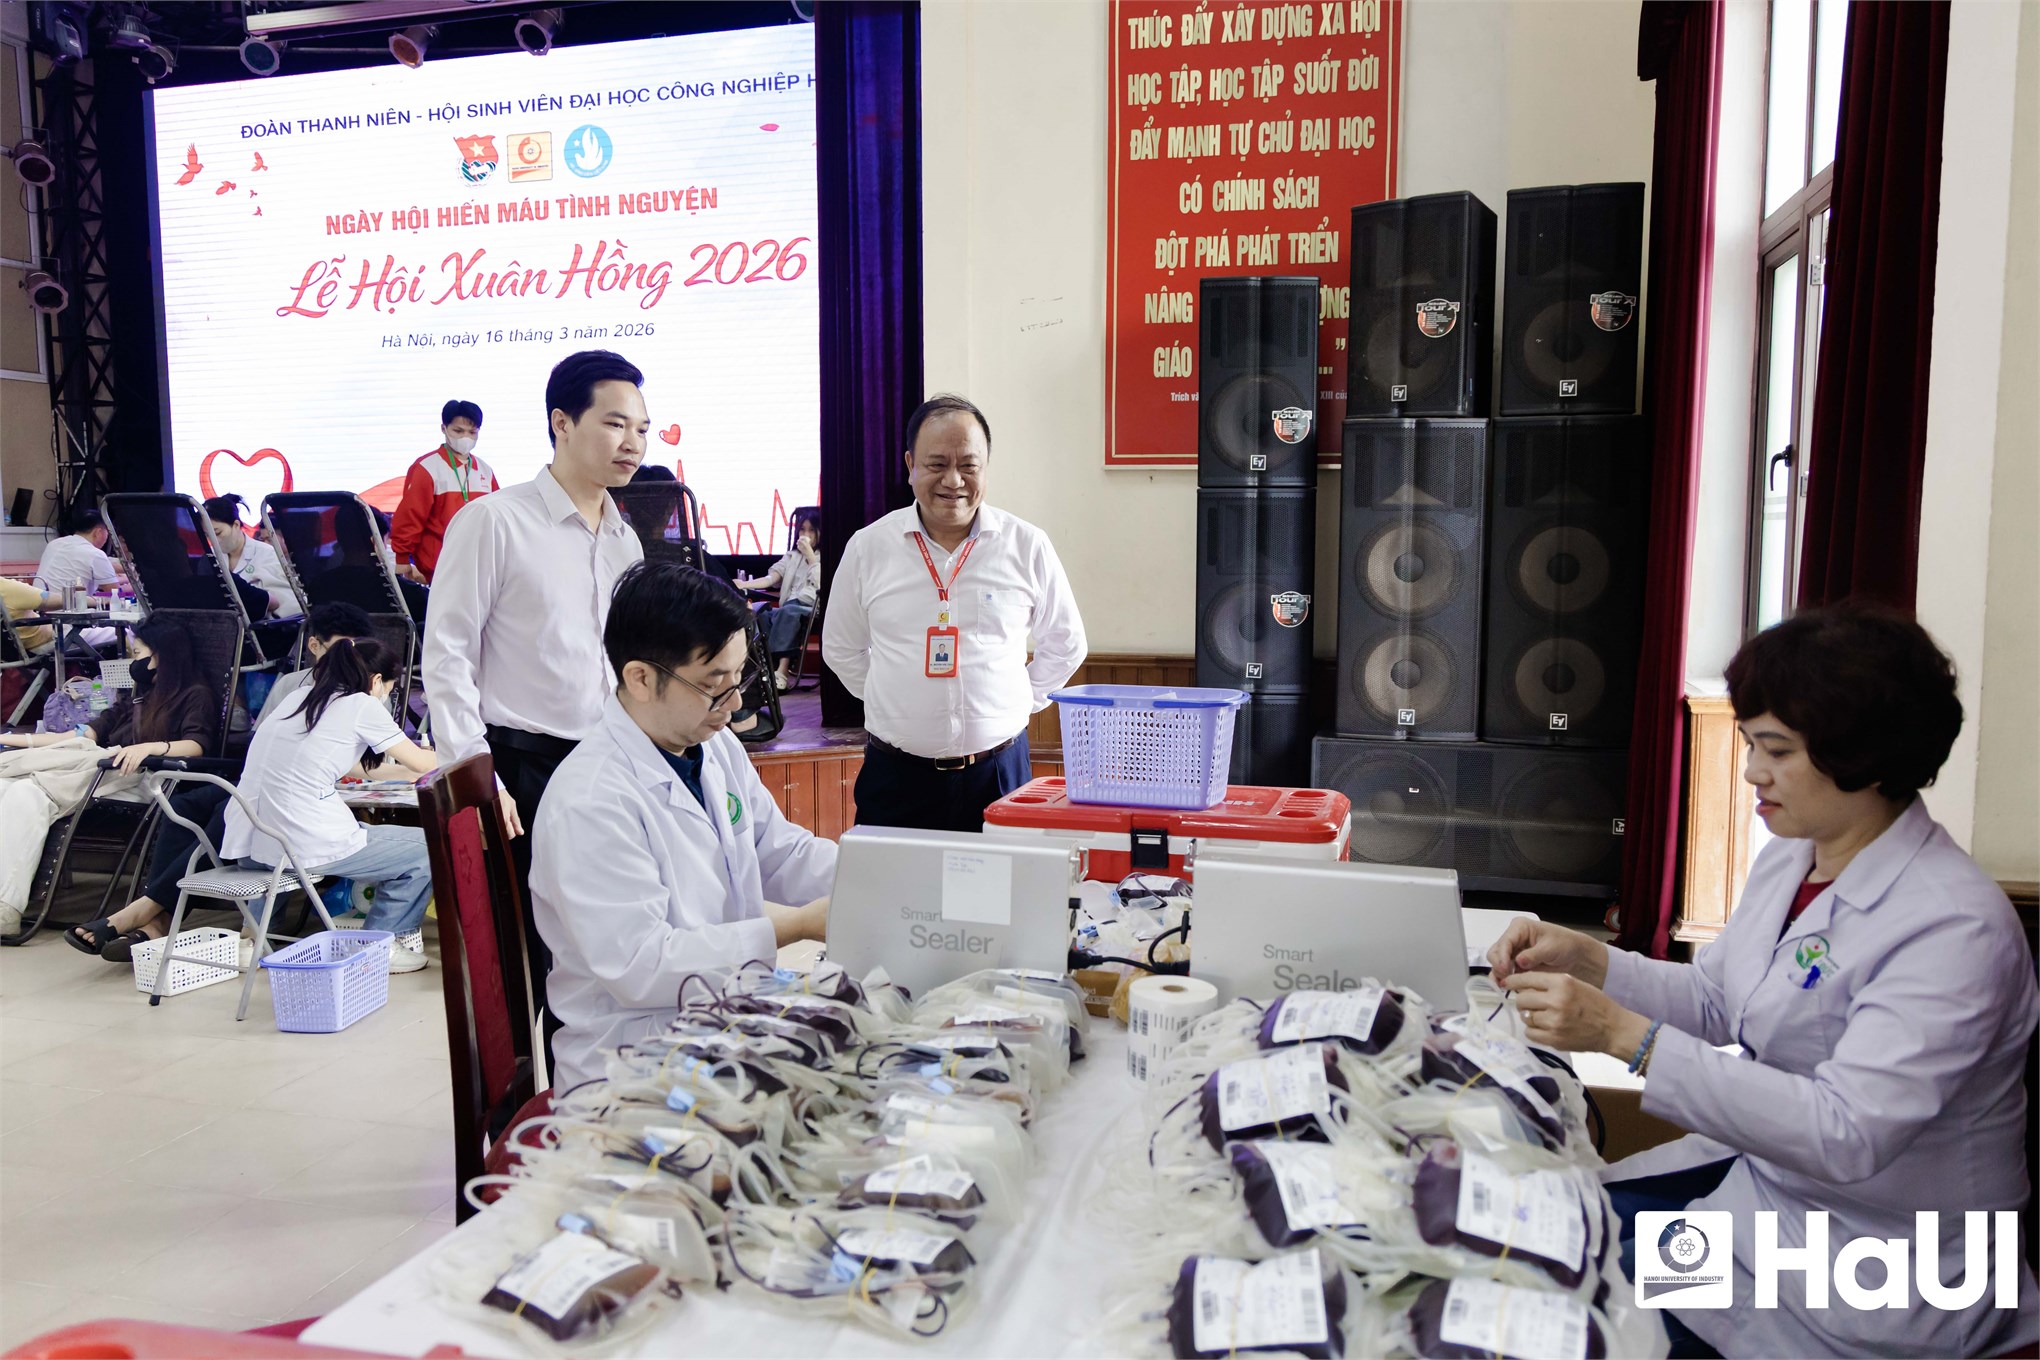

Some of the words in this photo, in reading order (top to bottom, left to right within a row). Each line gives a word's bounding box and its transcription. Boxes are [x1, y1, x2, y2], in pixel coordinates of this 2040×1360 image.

[1127, 9, 1172, 50] THÚC
[1181, 0, 1214, 47] ĐẨY
[1221, 2, 1256, 44] XÂY
[1261, 3, 1313, 46] DỰNG
[1127, 72, 1162, 112] HỌC
[1169, 63, 1202, 109] TẬP,
[1209, 66, 1245, 107] HỌC
[1251, 58, 1285, 104] TẬP
[1293, 47, 1342, 95] SUỐT
[1347, 48, 1380, 92] ĐỜI
[241, 119, 292, 139] ĐOÀN
[296, 114, 361, 134] THANH
[366, 107, 411, 127] NIÊN
[428, 102, 460, 124] HỘI
[467, 100, 512, 119] SINH
[517, 93, 563, 114] VIÊN
[568, 91, 601, 113] ĐẠI
[608, 87, 650, 110] HỌC
[656, 81, 715, 101] CÔNG
[722, 71, 800, 95] NGHIỆP
[807, 73, 817, 88] H
[1129, 115, 1162, 161] ĐẨY
[1167, 124, 1221, 164] MẠNH
[1228, 119, 1254, 162] TỰ
[1257, 109, 1294, 155] CHỦ
[1299, 117, 1331, 158] ĐẠI
[1338, 115, 1375, 156] HỌC
[326, 209, 383, 236] NGÀY
[391, 206, 429, 234] HỘI
[437, 199, 490, 228] HIẾN
[497, 196, 549, 223] MÁU
[555, 193, 610, 220] TÌNH
[618, 186, 718, 216] NGUYỆN
[1179, 174, 1203, 214] CÓ
[1212, 171, 1266, 213] CHÍNH
[1272, 168, 1320, 210] SÁCH
[1154, 229, 1189, 276] ĐỘT
[1194, 228, 1231, 268] PHÁ
[1236, 225, 1281, 266] PHÁT
[1287, 215, 1339, 265] TRIỂN
[275, 254, 346, 319] Lễ
[346, 254, 426, 315] Hội
[430, 248, 551, 306] Xuân
[554, 239, 673, 310] Hồng
[683, 236, 811, 288] 2026
[1144, 285, 1194, 324] NÂNG
[1319, 284, 1350, 326] ỢNG
[381, 333, 402, 348] Hà
[407, 333, 436, 350] Nội,
[441, 331, 480, 348] ngày
[486, 330, 504, 343] 16
[508, 328, 553, 344] tháng
[559, 326, 569, 340] 3
[573, 325, 608, 340] năm
[613, 322, 656, 338] 2026
[1153, 339, 1193, 378] GIÁO
[1170, 391, 1190, 402] Trích
[900, 906, 943, 922] Smart
[909, 924, 994, 954] Sealer
[1263, 944, 1314, 962] Smart
[1273, 964, 1362, 993] Seale
